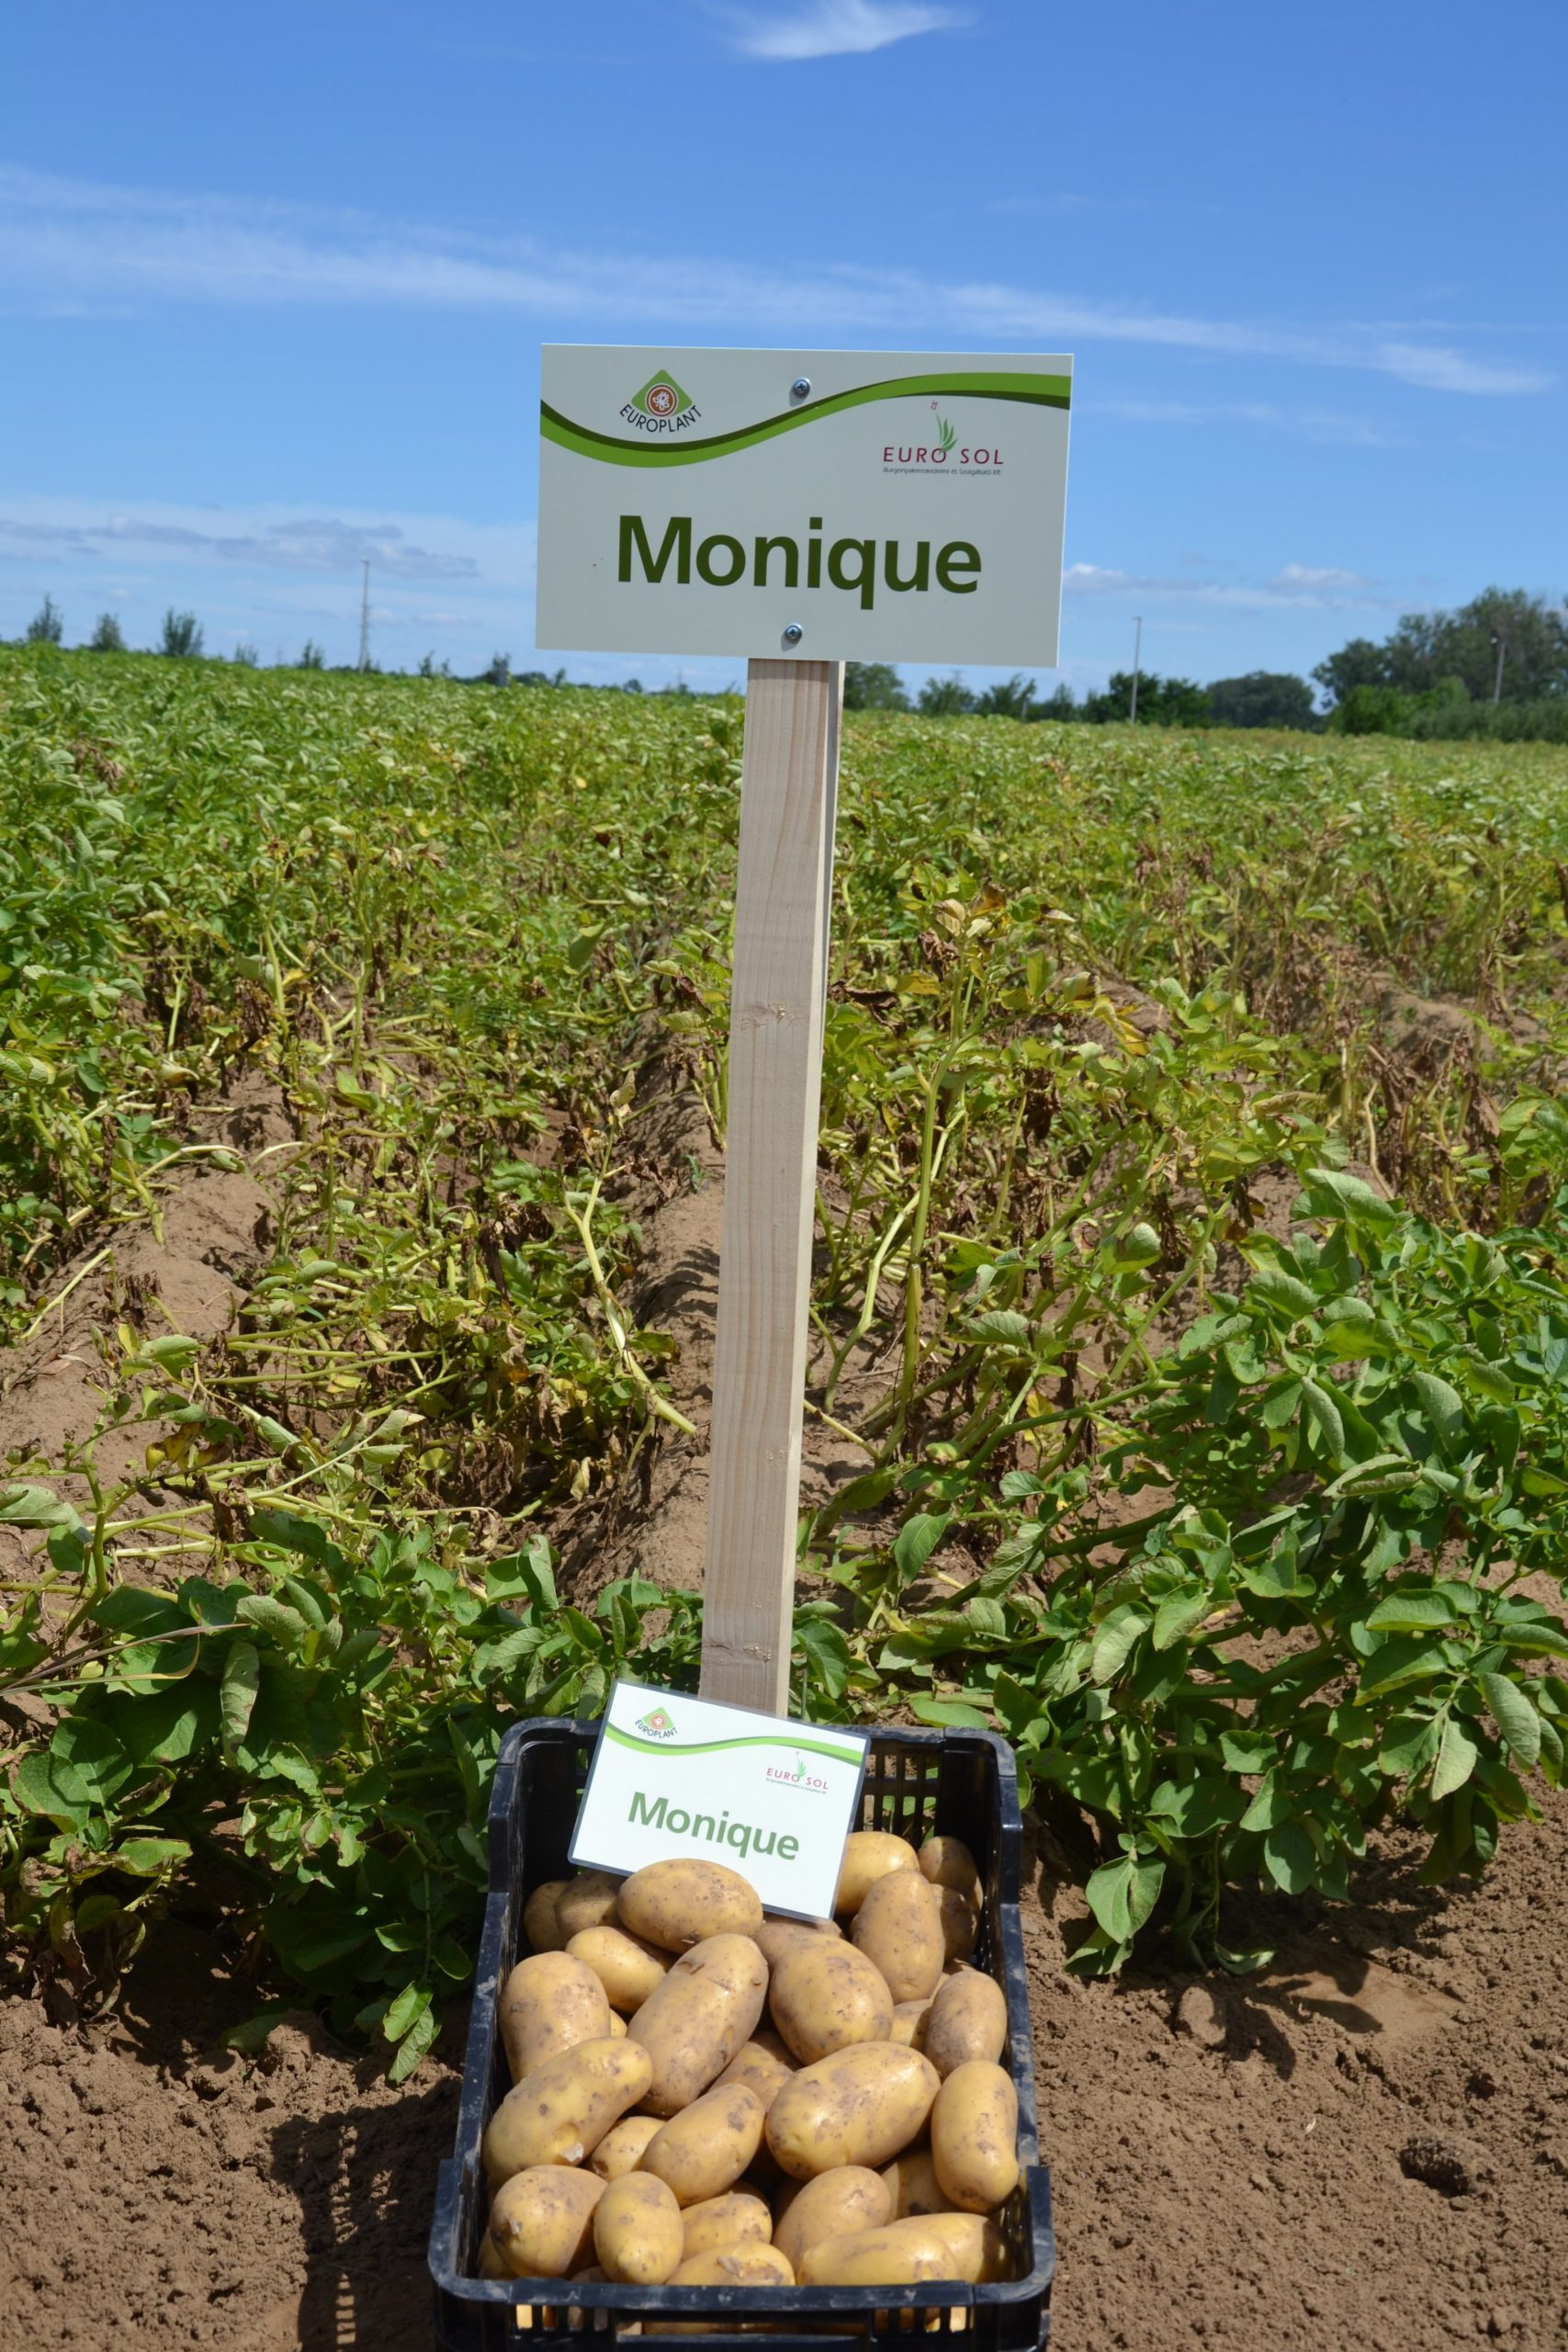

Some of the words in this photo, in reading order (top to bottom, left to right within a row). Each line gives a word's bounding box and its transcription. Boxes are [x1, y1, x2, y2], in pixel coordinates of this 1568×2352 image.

[619, 404, 702, 433] EUROPLANT
[884, 447, 947, 463] EURO
[960, 448, 1004, 465] SOL
[618, 514, 982, 610] Monique
[635, 1719, 678, 1738] EUROPLANT
[766, 1768, 800, 1782] EURO
[806, 1777, 829, 1790] SOL
[627, 1791, 799, 1860] Monique
